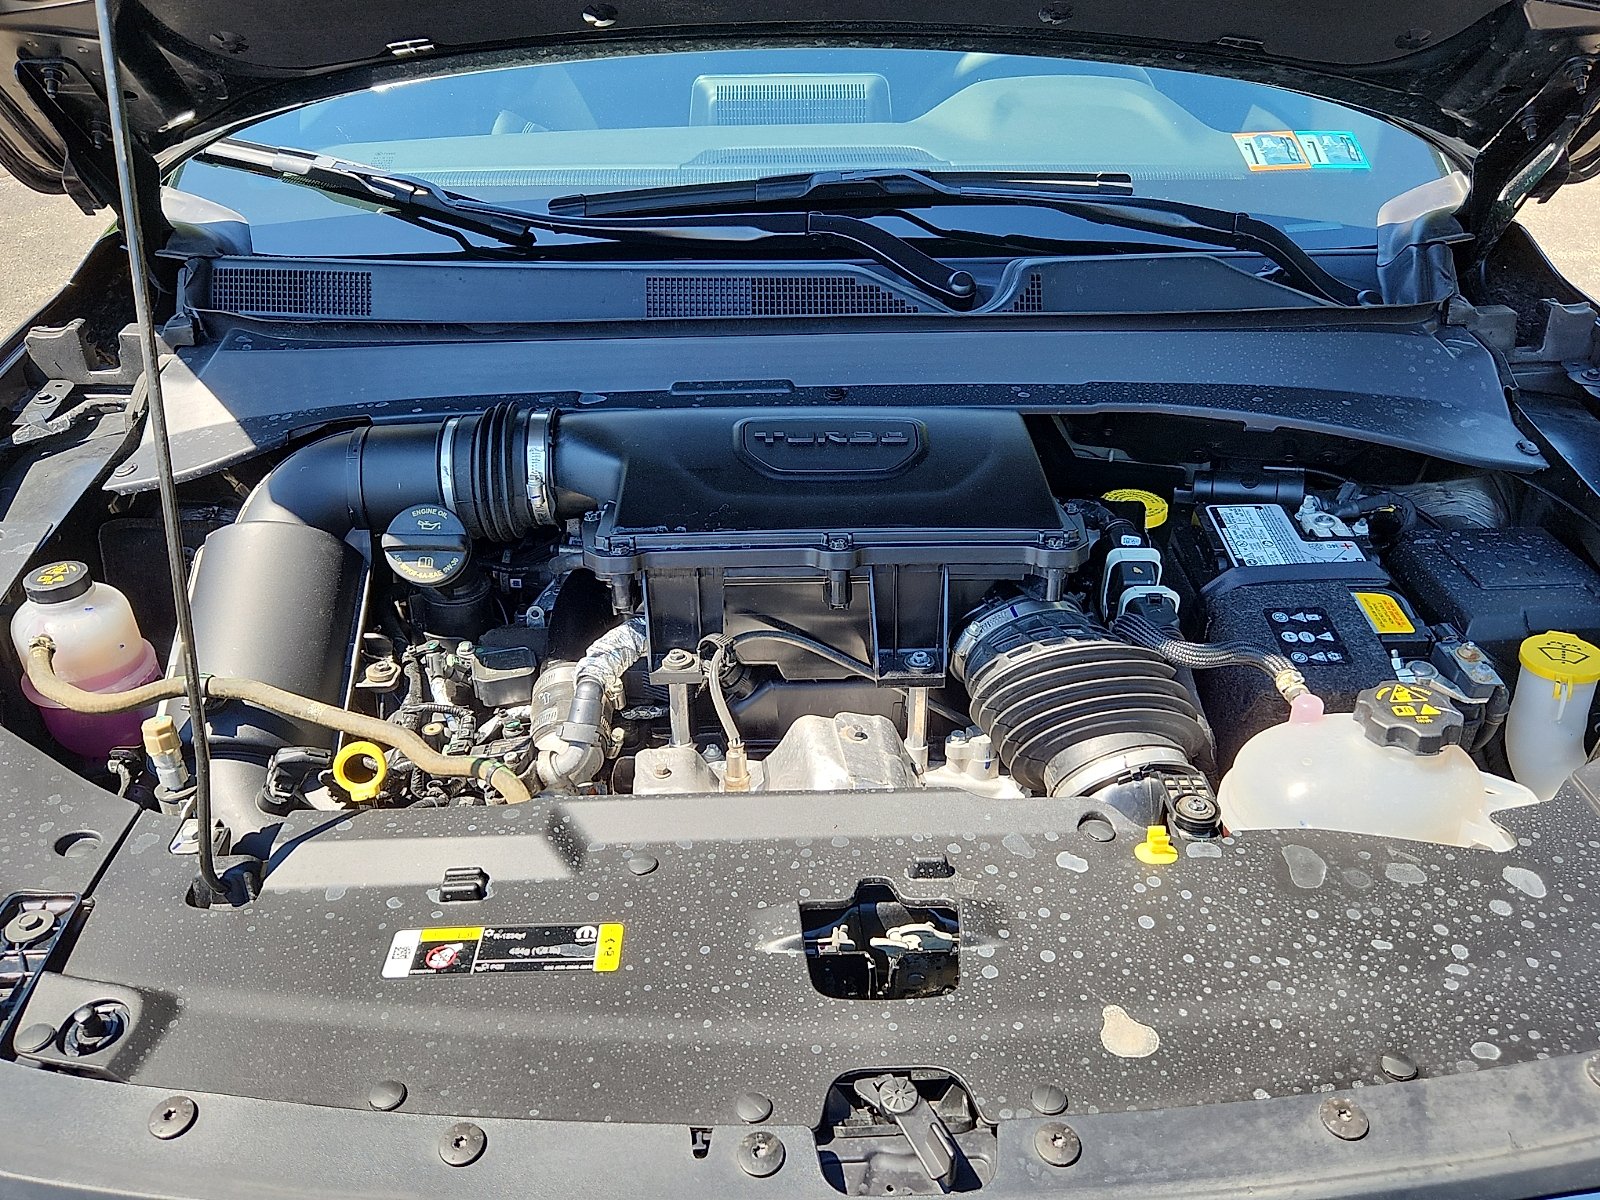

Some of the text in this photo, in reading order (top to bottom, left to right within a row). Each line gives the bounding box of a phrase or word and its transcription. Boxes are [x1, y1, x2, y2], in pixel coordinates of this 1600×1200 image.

[754, 431, 909, 445] TURBO
[411, 508, 448, 520] ENGINE OIL
